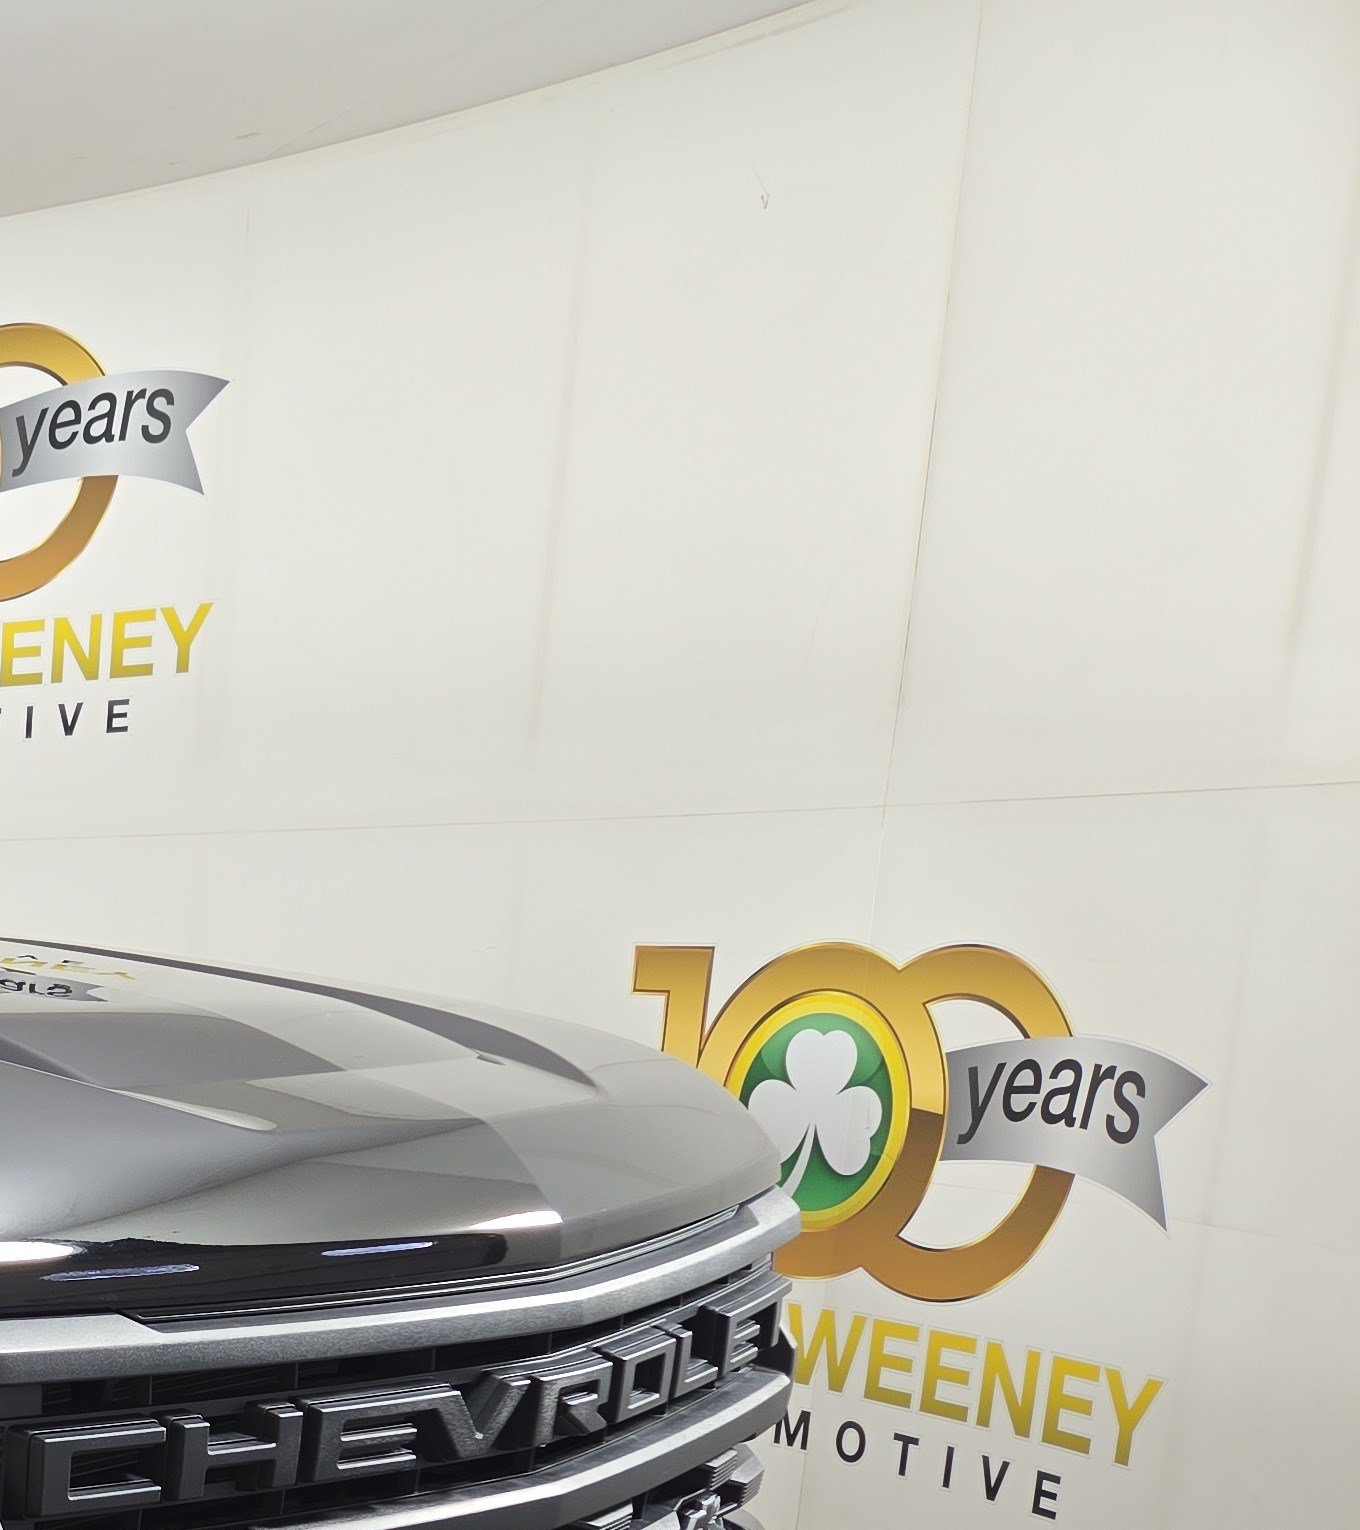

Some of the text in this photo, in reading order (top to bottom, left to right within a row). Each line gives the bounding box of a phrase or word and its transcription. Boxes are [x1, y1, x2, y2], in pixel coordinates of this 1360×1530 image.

[11, 386, 175, 478] years
[957, 1058, 1146, 1145] years
[15, 1276, 794, 1517] CHEVROLET
[787, 1303, 1164, 1467] WEENEY
